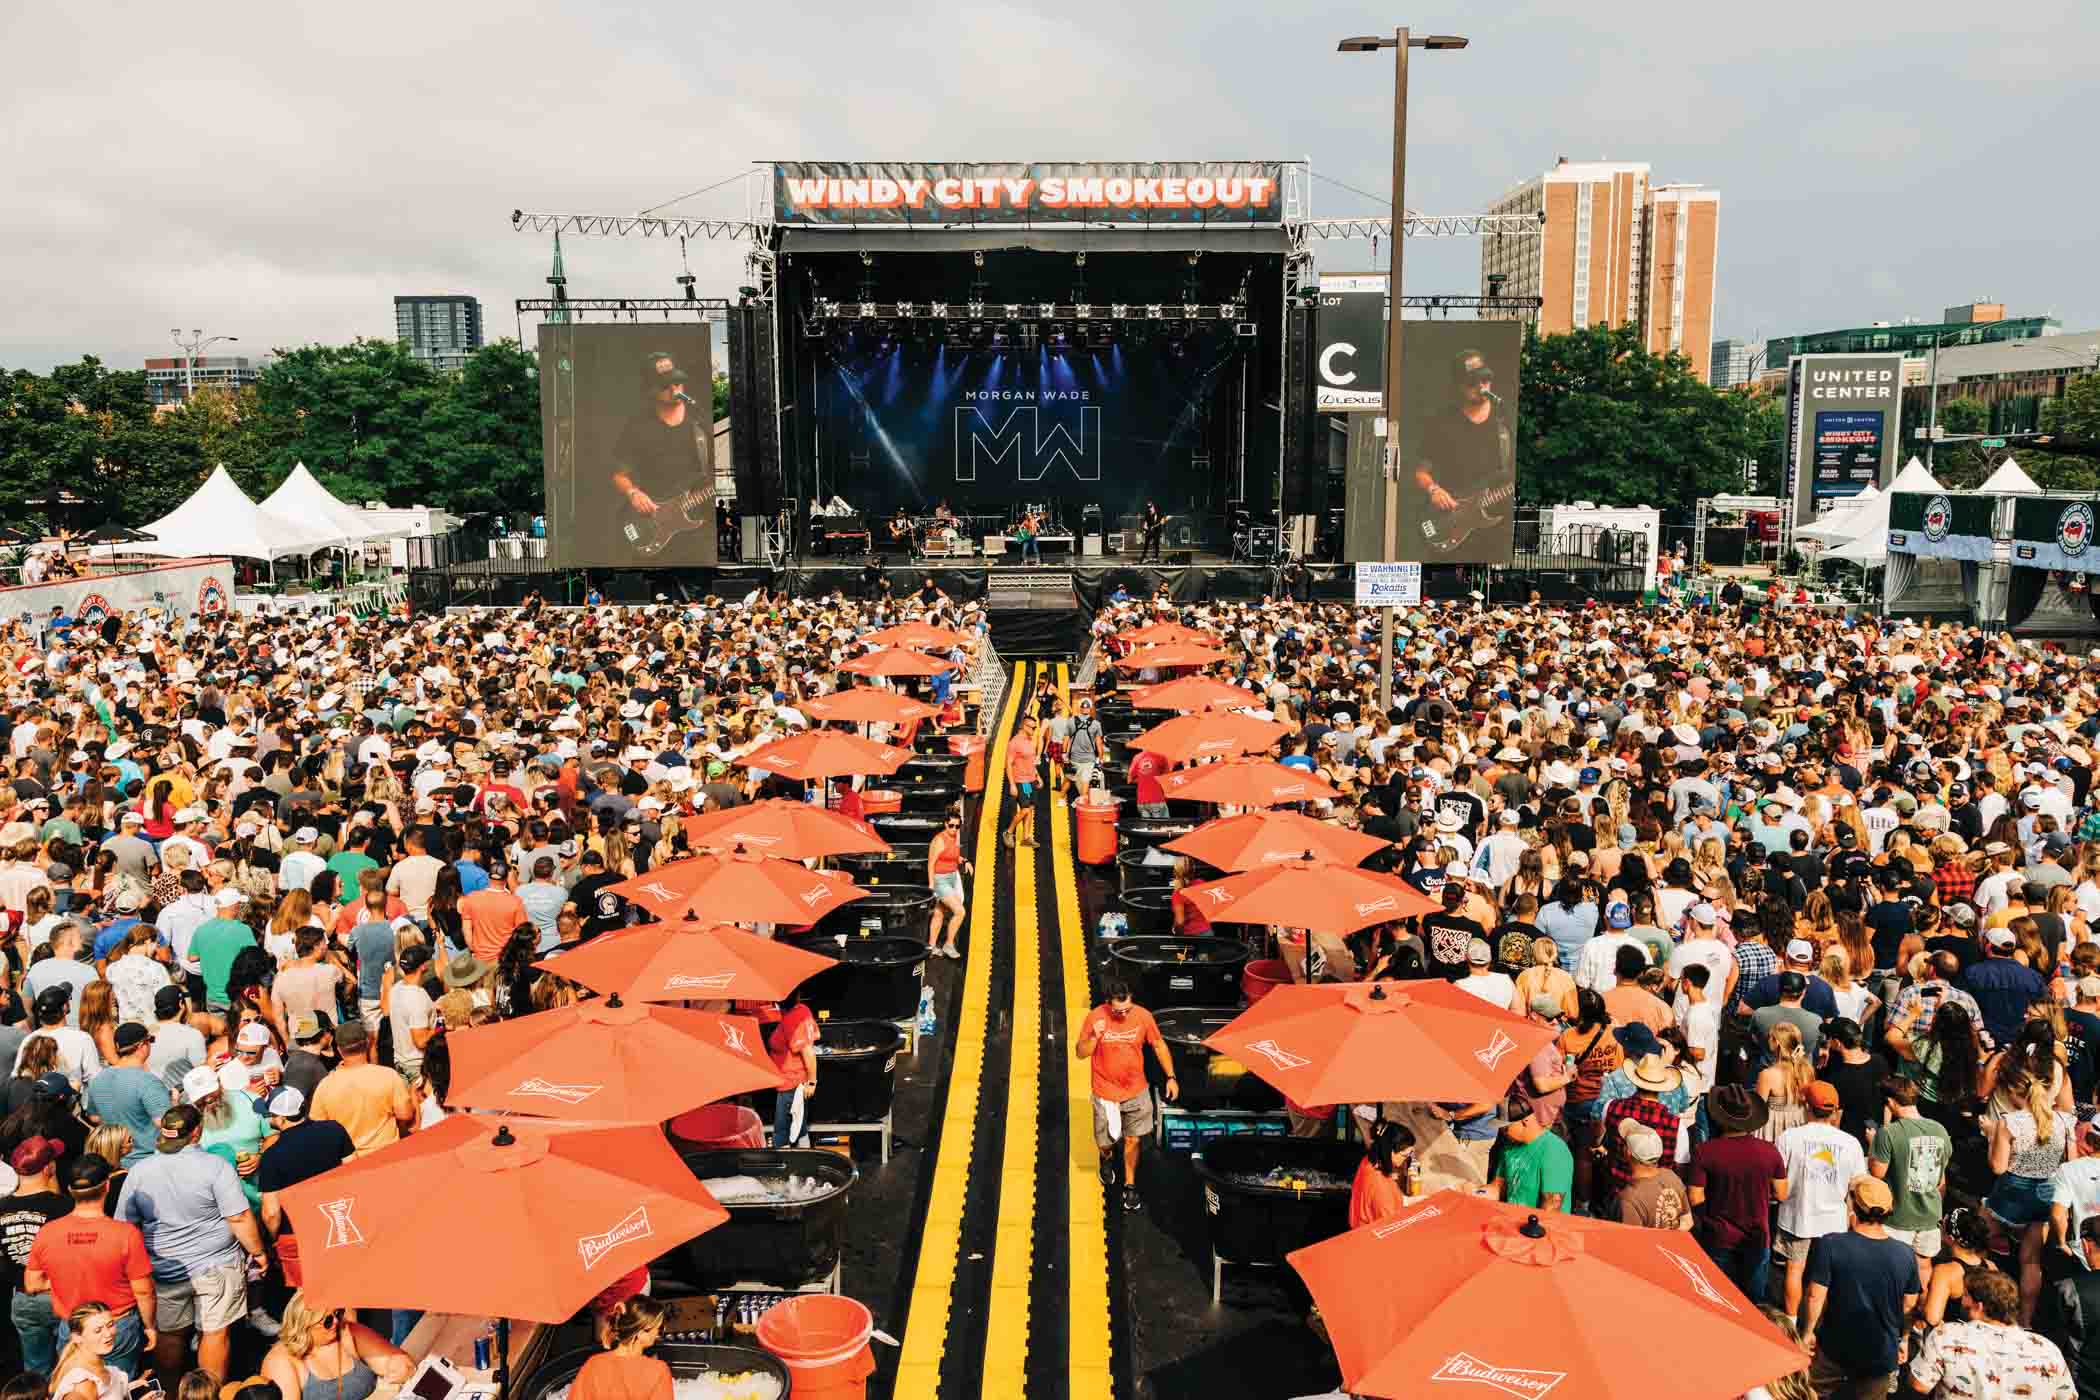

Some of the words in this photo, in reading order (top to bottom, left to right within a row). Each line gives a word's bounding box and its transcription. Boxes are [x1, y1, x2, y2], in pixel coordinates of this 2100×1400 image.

[785, 178, 927, 209] WINDY
[934, 178, 1035, 209] CITY
[1039, 178, 1275, 209] SMOKEOUT
[1322, 297, 1342, 306] LOT
[1319, 342, 1358, 385] C
[1813, 370, 1893, 382] UNITED
[965, 391, 1035, 400] MORGAN
[1043, 391, 1090, 400] WADE
[1336, 396, 1381, 404] LEXUS
[1812, 386, 1891, 398] CENTER
[954, 406, 1100, 480] MW
[582, 1218, 645, 1257] Budweiser
[1446, 1357, 1553, 1391] Budweiser
